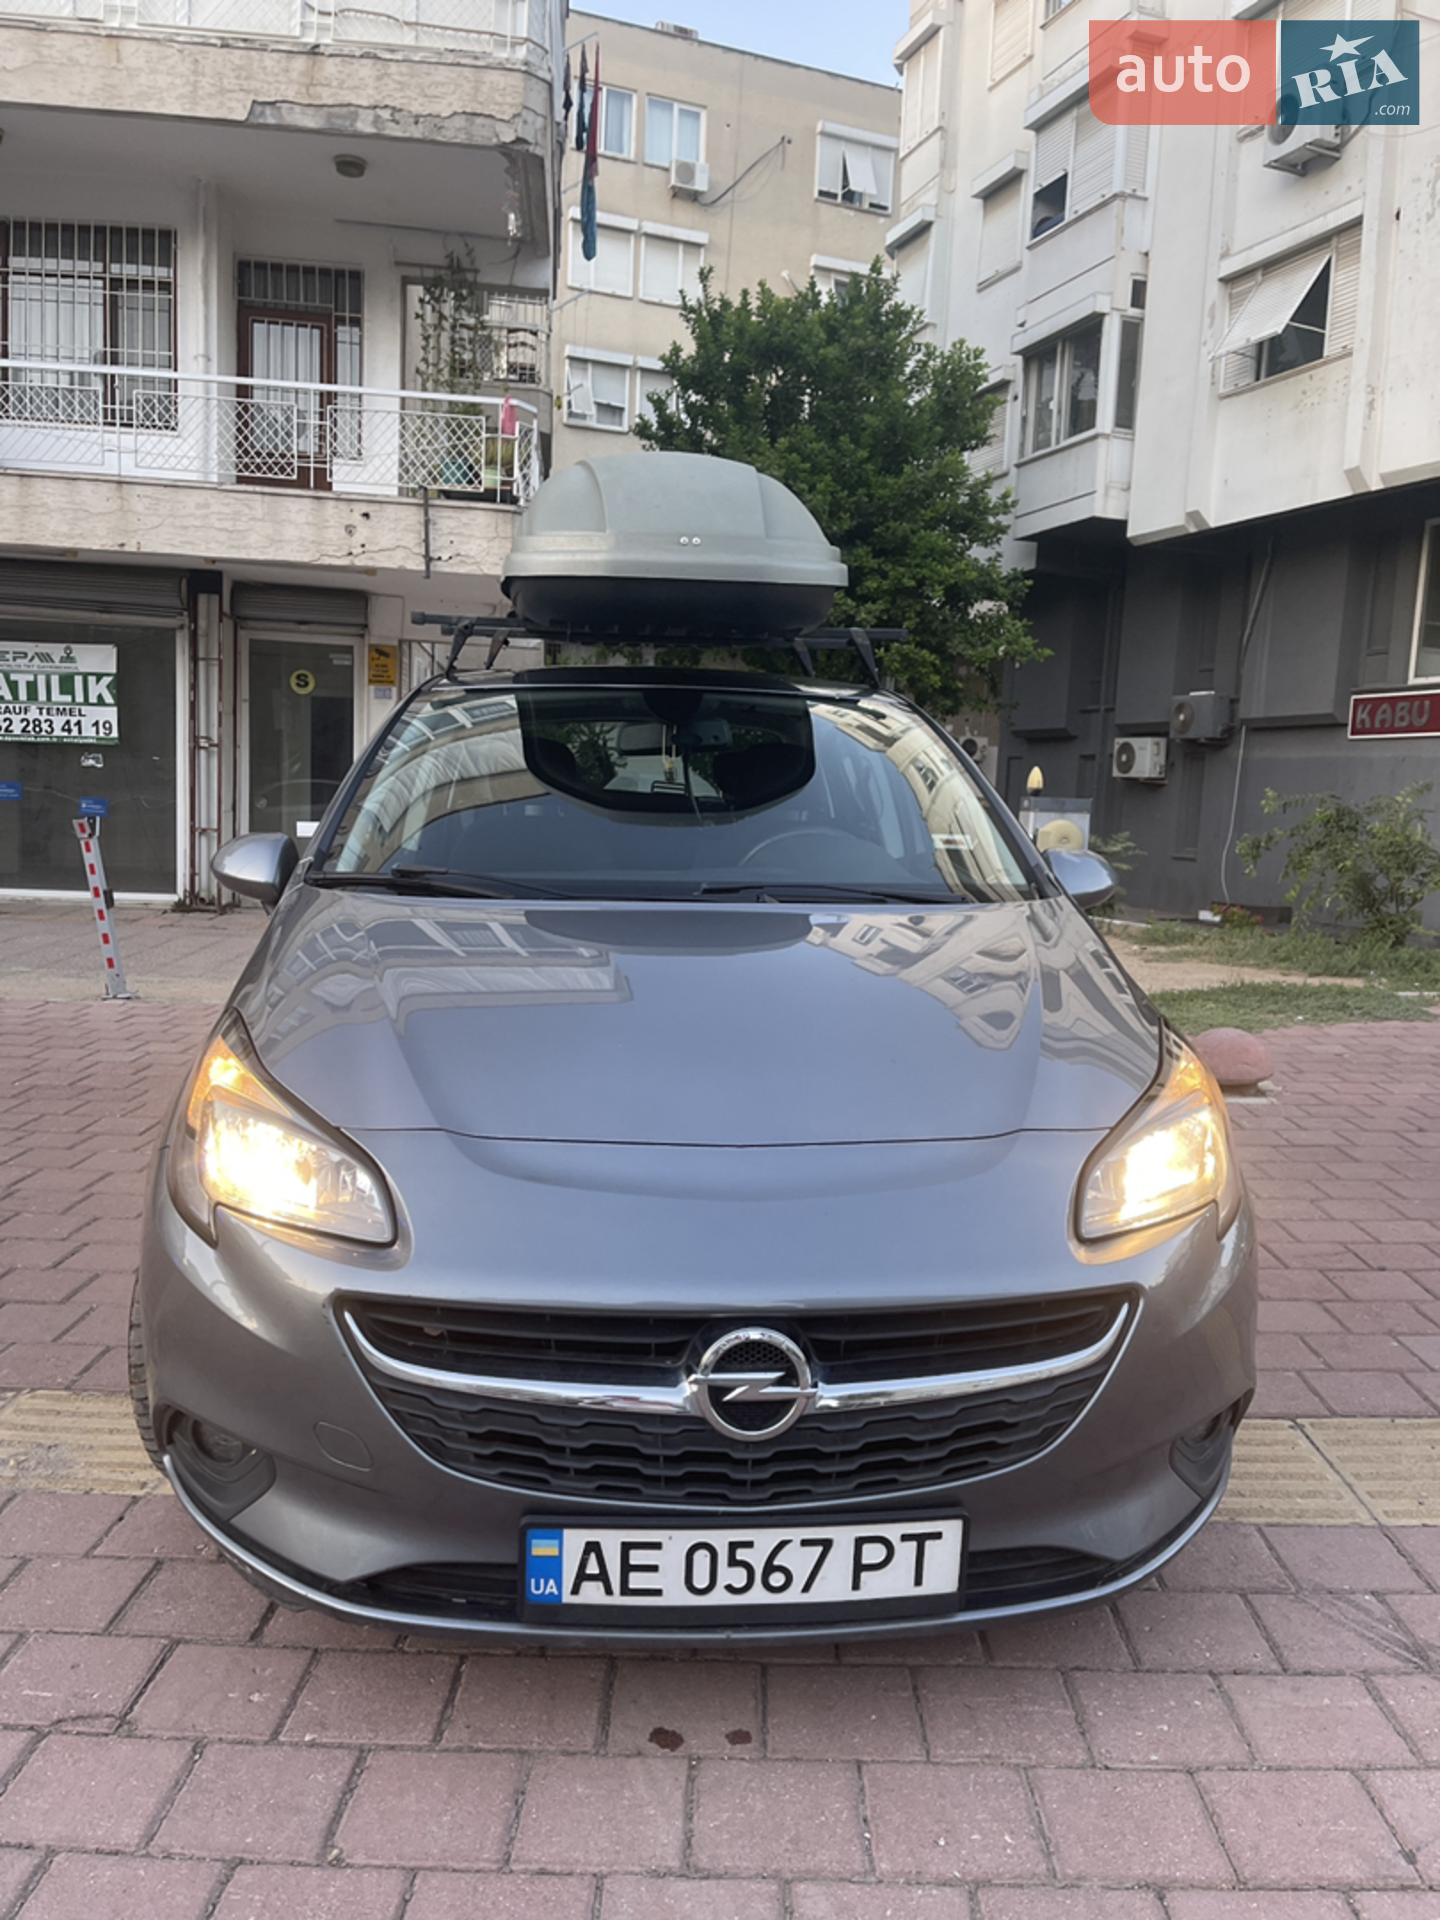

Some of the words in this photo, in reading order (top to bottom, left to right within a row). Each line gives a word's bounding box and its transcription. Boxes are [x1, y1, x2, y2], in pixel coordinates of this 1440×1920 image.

[295, 673, 310, 688] S
[36, 706, 87, 717] TEMEL
[1355, 700, 1430, 729] KABU
[0, 717, 14, 733] 2
[20, 717, 54, 735] 283
[61, 719, 82, 735] 41
[92, 719, 113, 736] 19
[570, 1540, 663, 1597] AE
[684, 1538, 834, 1596] 0567
[851, 1531, 943, 1592] PT
[530, 1578, 559, 1596] UA
